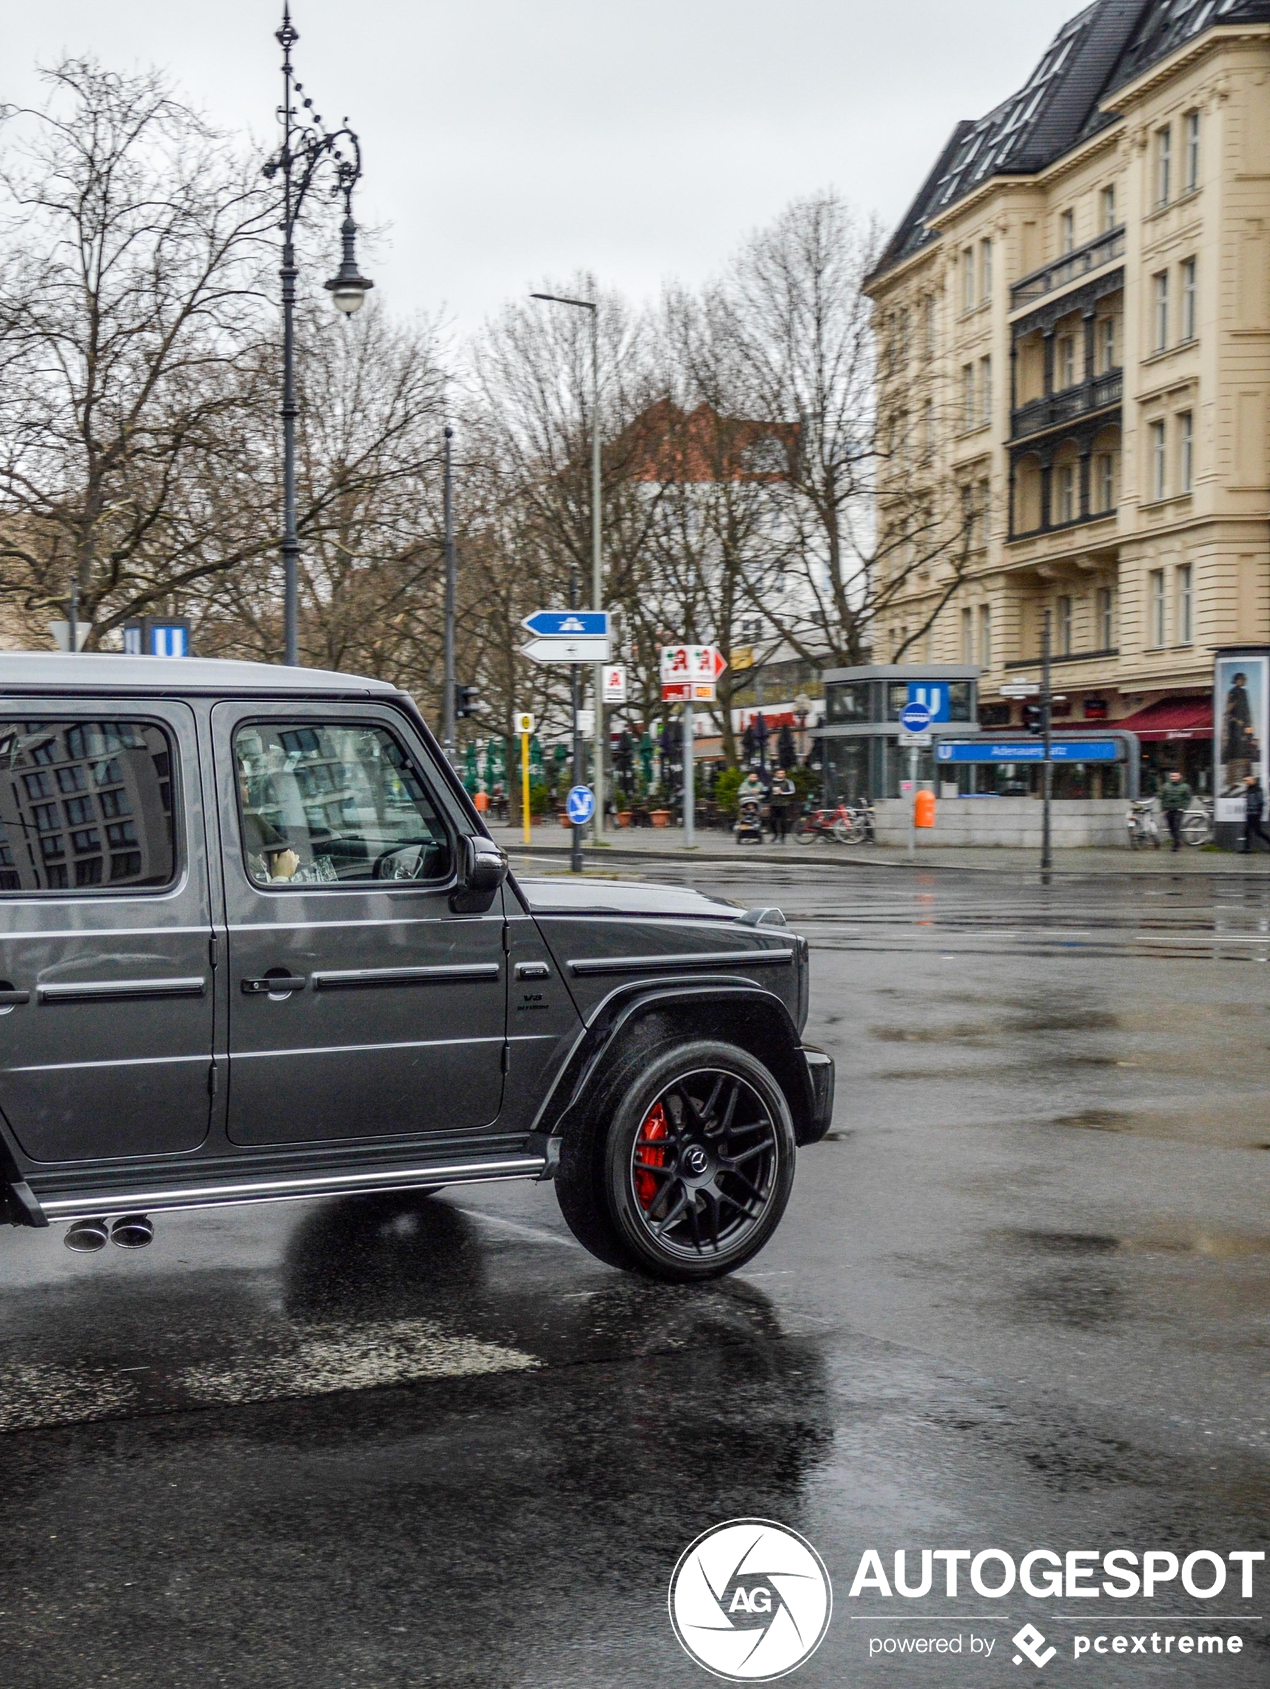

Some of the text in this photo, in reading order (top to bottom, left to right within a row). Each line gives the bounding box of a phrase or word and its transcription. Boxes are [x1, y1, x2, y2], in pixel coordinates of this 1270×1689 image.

[154, 629, 183, 657] U
[915, 688, 941, 716] U
[991, 746, 1067, 757] Adenauerpatz
